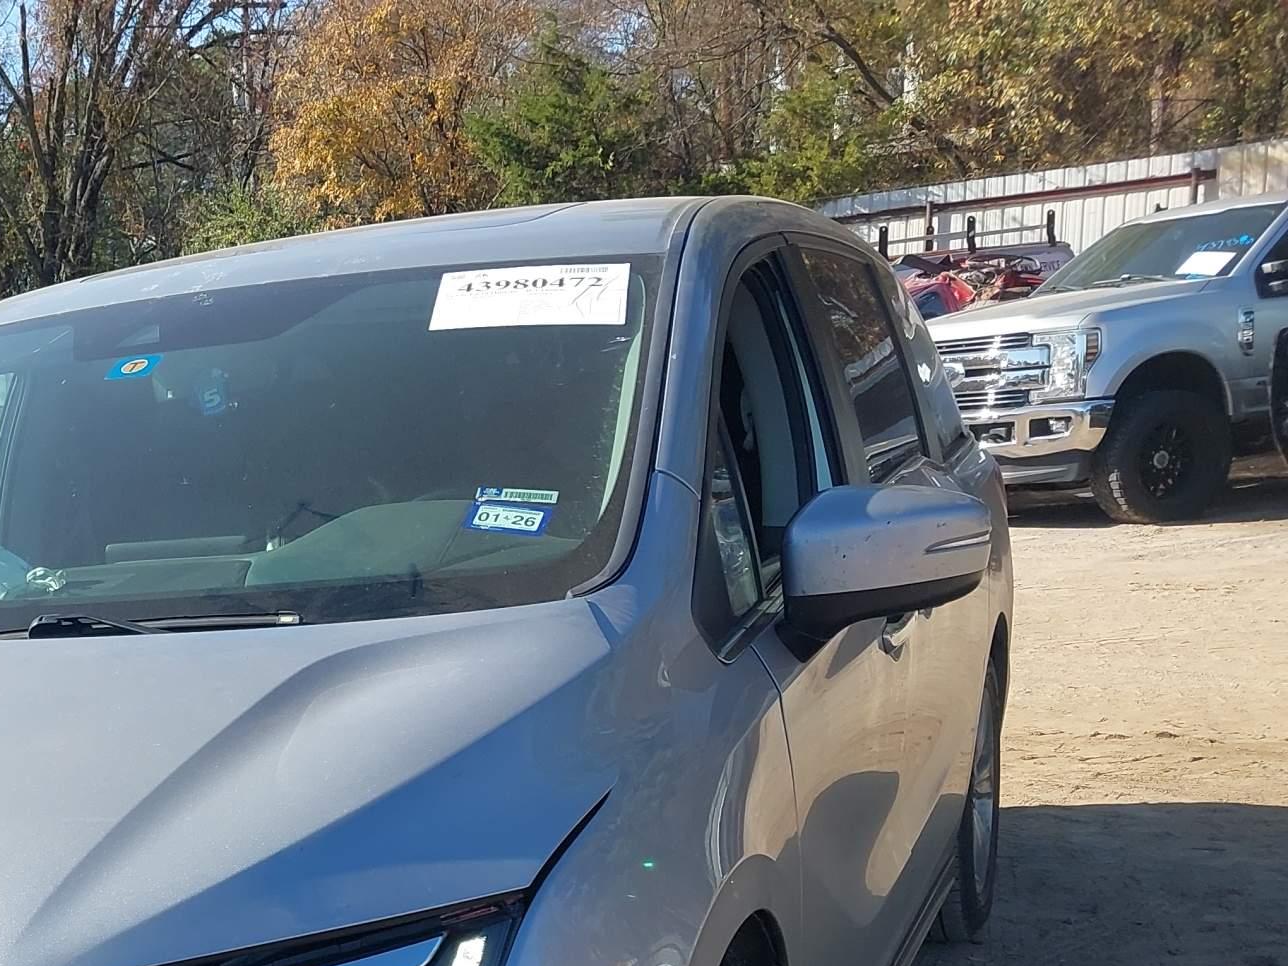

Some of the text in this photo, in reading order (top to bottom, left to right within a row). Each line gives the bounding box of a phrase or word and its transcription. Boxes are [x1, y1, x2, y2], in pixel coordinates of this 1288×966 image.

[458, 276, 603, 293] 43980472
[478, 511, 500, 523] 01
[511, 515, 537, 527] 26
